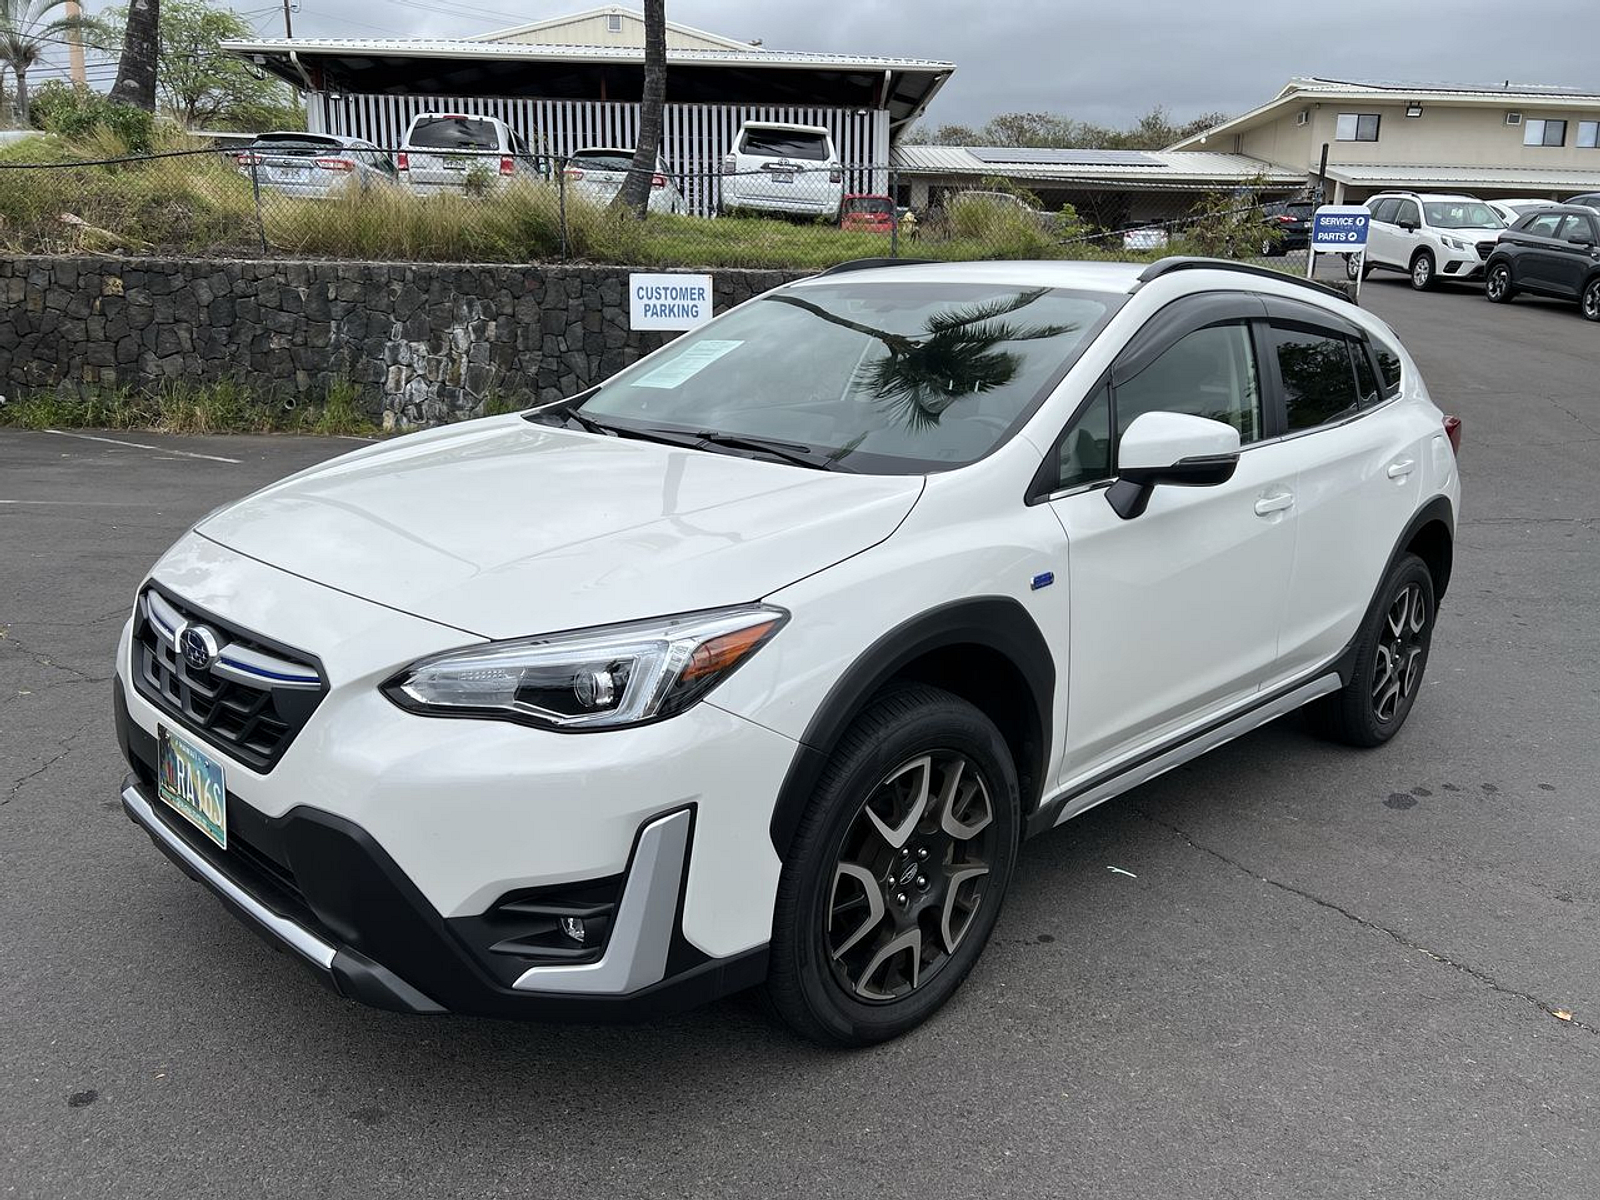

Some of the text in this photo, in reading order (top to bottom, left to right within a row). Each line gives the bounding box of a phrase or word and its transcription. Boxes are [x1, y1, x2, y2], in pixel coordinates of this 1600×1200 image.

[1320, 217, 1354, 225] SERVICE
[1317, 232, 1346, 240] PARTS
[636, 286, 706, 301] CUSTOMER
[643, 303, 699, 318] PARKING
